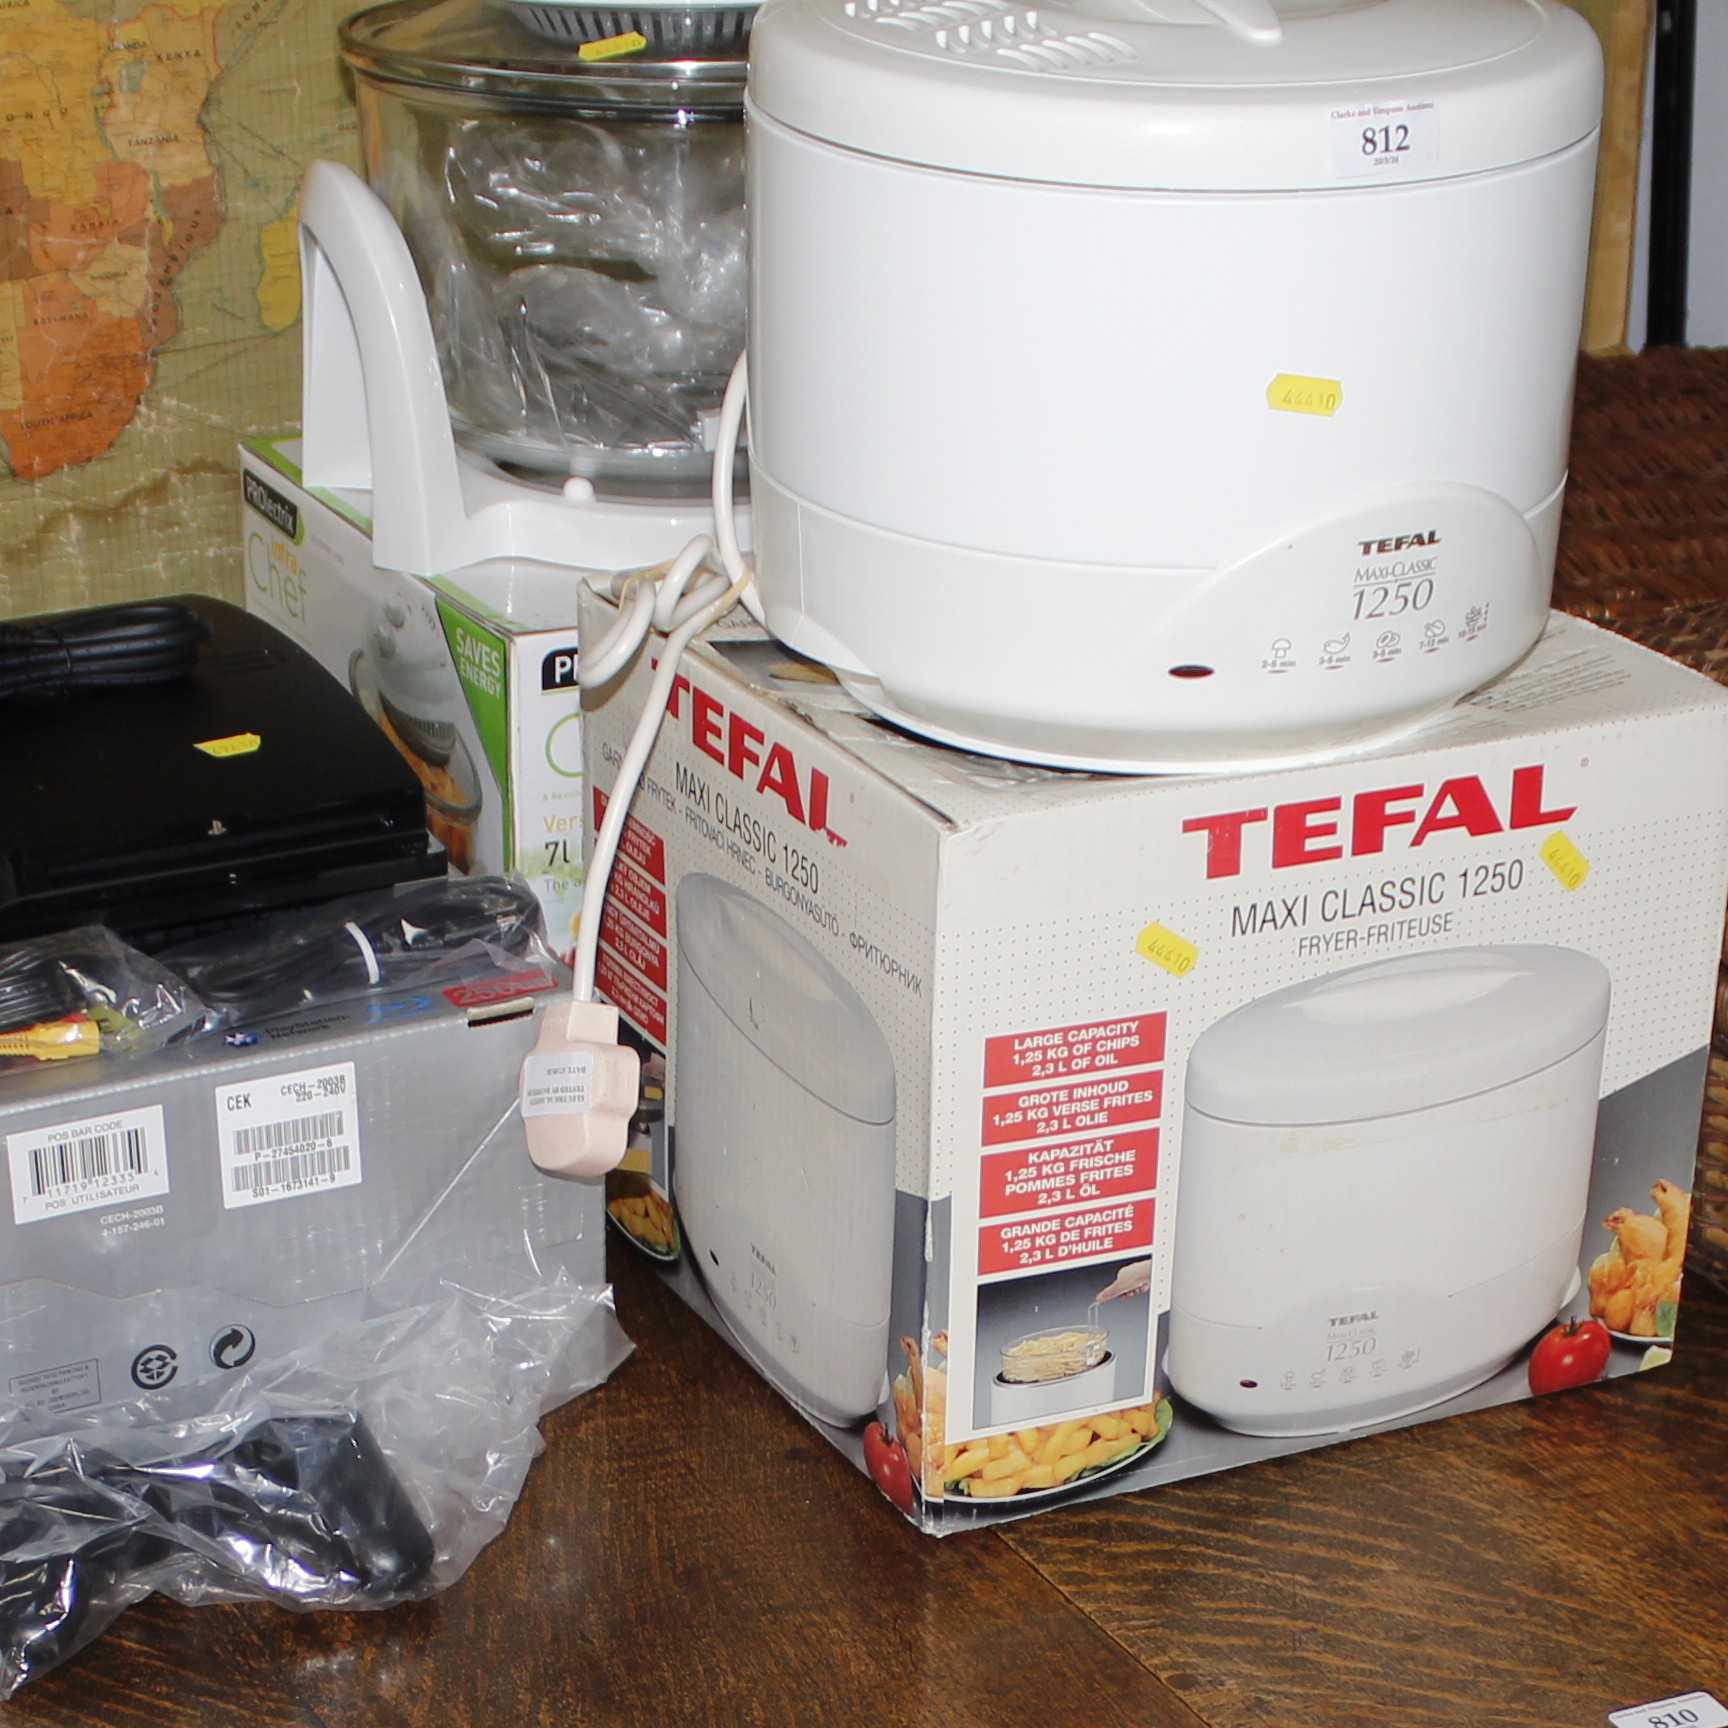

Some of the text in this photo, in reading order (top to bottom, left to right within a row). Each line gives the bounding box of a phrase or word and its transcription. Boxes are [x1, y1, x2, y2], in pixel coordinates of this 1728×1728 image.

[155, 48, 203, 64] KENYA
[128, 135, 180, 148] TANZANIA
[1361, 124, 1410, 156] 812
[1358, 529, 1442, 556] TEFAL
[249, 531, 307, 625] Chef
[1354, 557, 1438, 583] MAXI-CLASSIC
[1352, 578, 1434, 621] 1250
[455, 627, 501, 674] SAVES
[459, 659, 502, 698] ENERGY
[675, 762, 820, 894] MAXI CLASSIC 1250
[1181, 763, 1578, 880] TEFAL
[1231, 858, 1525, 937] MAXI CLASSIC 1250
[1297, 911, 1455, 958] FRYER-FRITEUSE
[848, 930, 924, 998] ФРИТЮРНИК
[1013, 1035, 1140, 1067] 1,25 KG OF CHIPS
[1014, 1021, 1140, 1051] LARGE CAPACITY
[1032, 1053, 1118, 1077] 2,3 L OF OIL
[226, 1093, 252, 1112] CEK
[993, 1090, 1153, 1127] 1,25 KG VERSE FRITES
[1018, 1081, 1129, 1108] GROTE INHOUD
[47, 1120, 123, 1143] POS BAR CODE
[1036, 1112, 1109, 1134] 2,3 L OLIE
[1005, 1149, 1136, 1182] 1,25 KG FRISCHE
[1028, 1139, 1114, 1164] KAPAZITÄT
[1005, 1164, 1134, 1196] POMMES FRITES
[1037, 1184, 1100, 1205] 2,3 L ÖL
[44, 1182, 140, 1211] POS UTILISATEUR
[1001, 1204, 1134, 1239] GRANDE CAPACITÉ
[1002, 1221, 1133, 1254] 1,25 KG DE FRITES
[1019, 1237, 1114, 1265] 2,3 L D'HUILE
